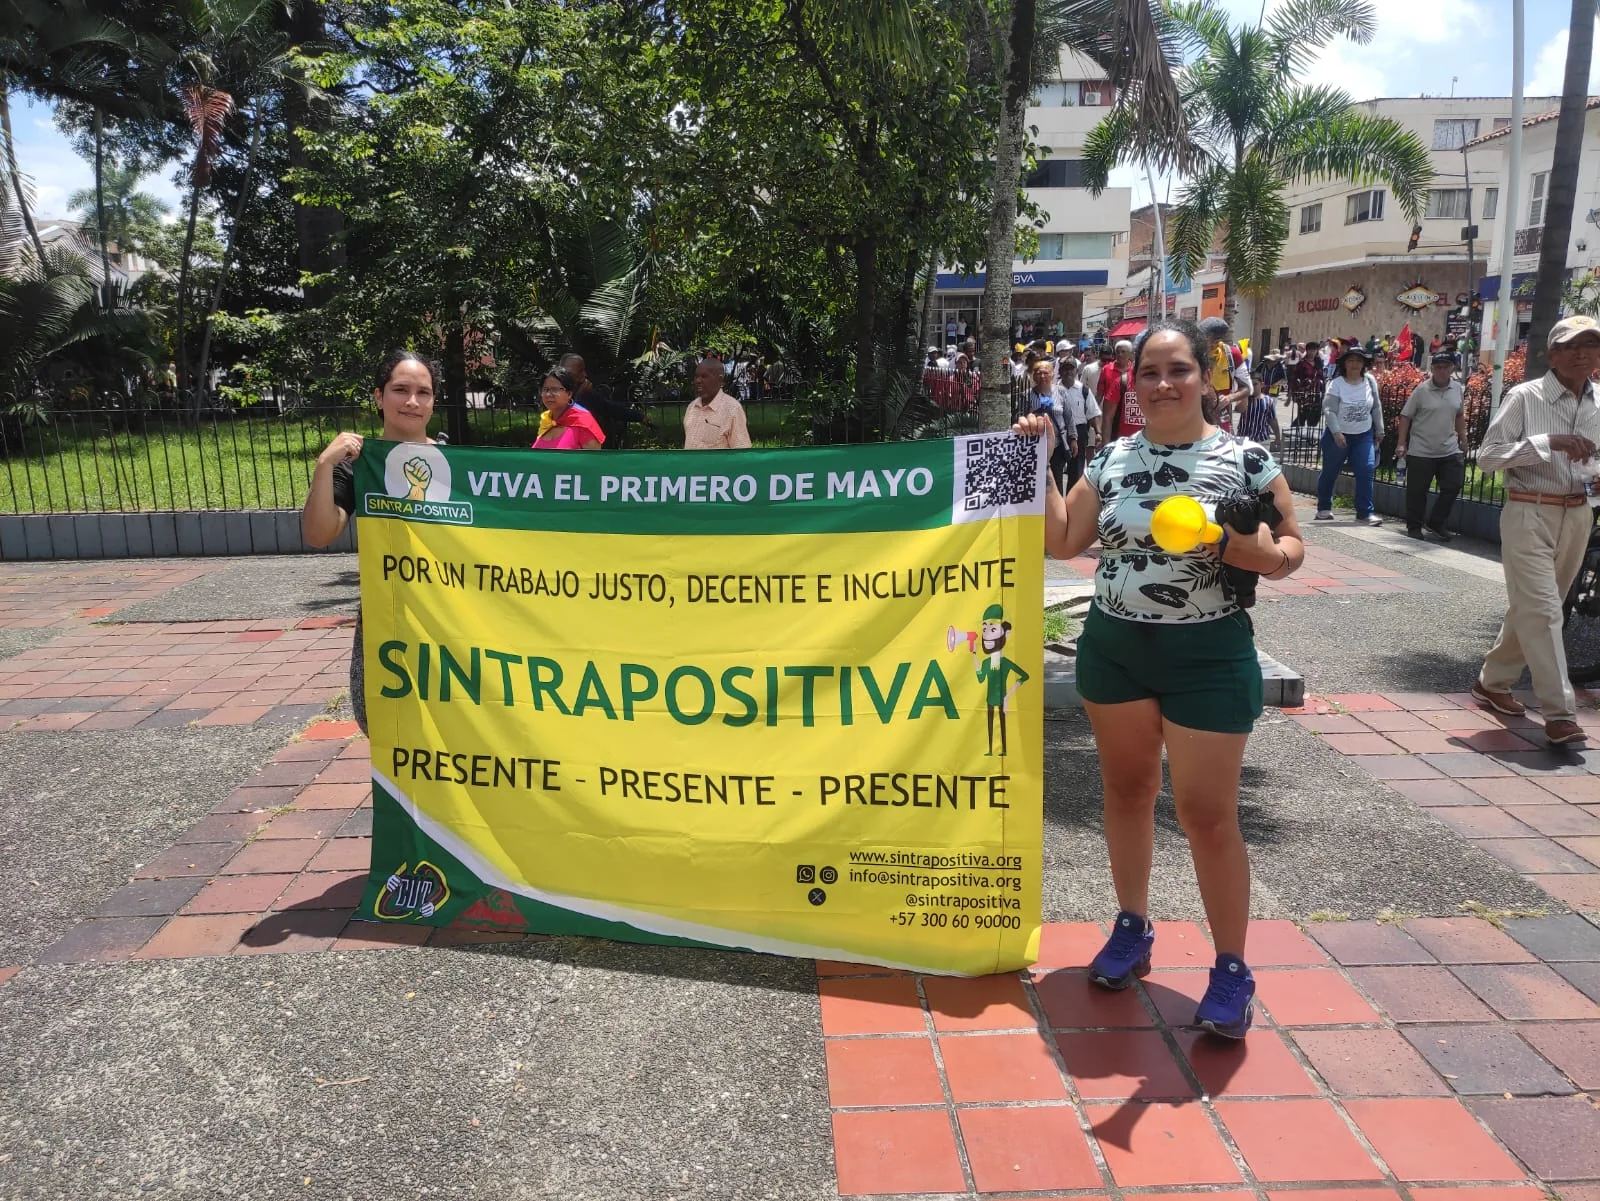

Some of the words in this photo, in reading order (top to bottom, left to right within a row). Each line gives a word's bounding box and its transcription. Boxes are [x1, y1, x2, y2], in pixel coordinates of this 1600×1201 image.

[1013, 274, 1035, 285] BVA
[467, 471, 543, 498] VIVA
[554, 475, 590, 500] EL
[601, 475, 757, 502] PRIMERO
[769, 473, 814, 501] DE
[827, 467, 934, 499] MAYO
[369, 498, 469, 519] SINTRAPOSITIVA
[383, 555, 432, 583] POR
[435, 561, 465, 590] UN
[474, 564, 579, 598] TRABAJO
[589, 572, 675, 608] JUSTO,
[687, 575, 807, 603] DECENTE
[817, 575, 832, 603] E
[843, 558, 1016, 601] INCLUYENTE
[378, 640, 960, 727] SINTRAPOSITIVA
[392, 748, 561, 791] PRESENTE
[600, 767, 775, 805] PRESENTE
[820, 773, 1011, 809] PRESENTE
[849, 851, 1022, 870] www.sintrapositiva.org
[849, 868, 1022, 891] info@sintrapositiva.org
[395, 878, 433, 909] CUT
[905, 893, 1021, 911] @sintrapositiva
[889, 912, 916, 926] +57
[921, 912, 947, 928] 300
[952, 914, 969, 929] 60
[974, 915, 1021, 930] 90000
